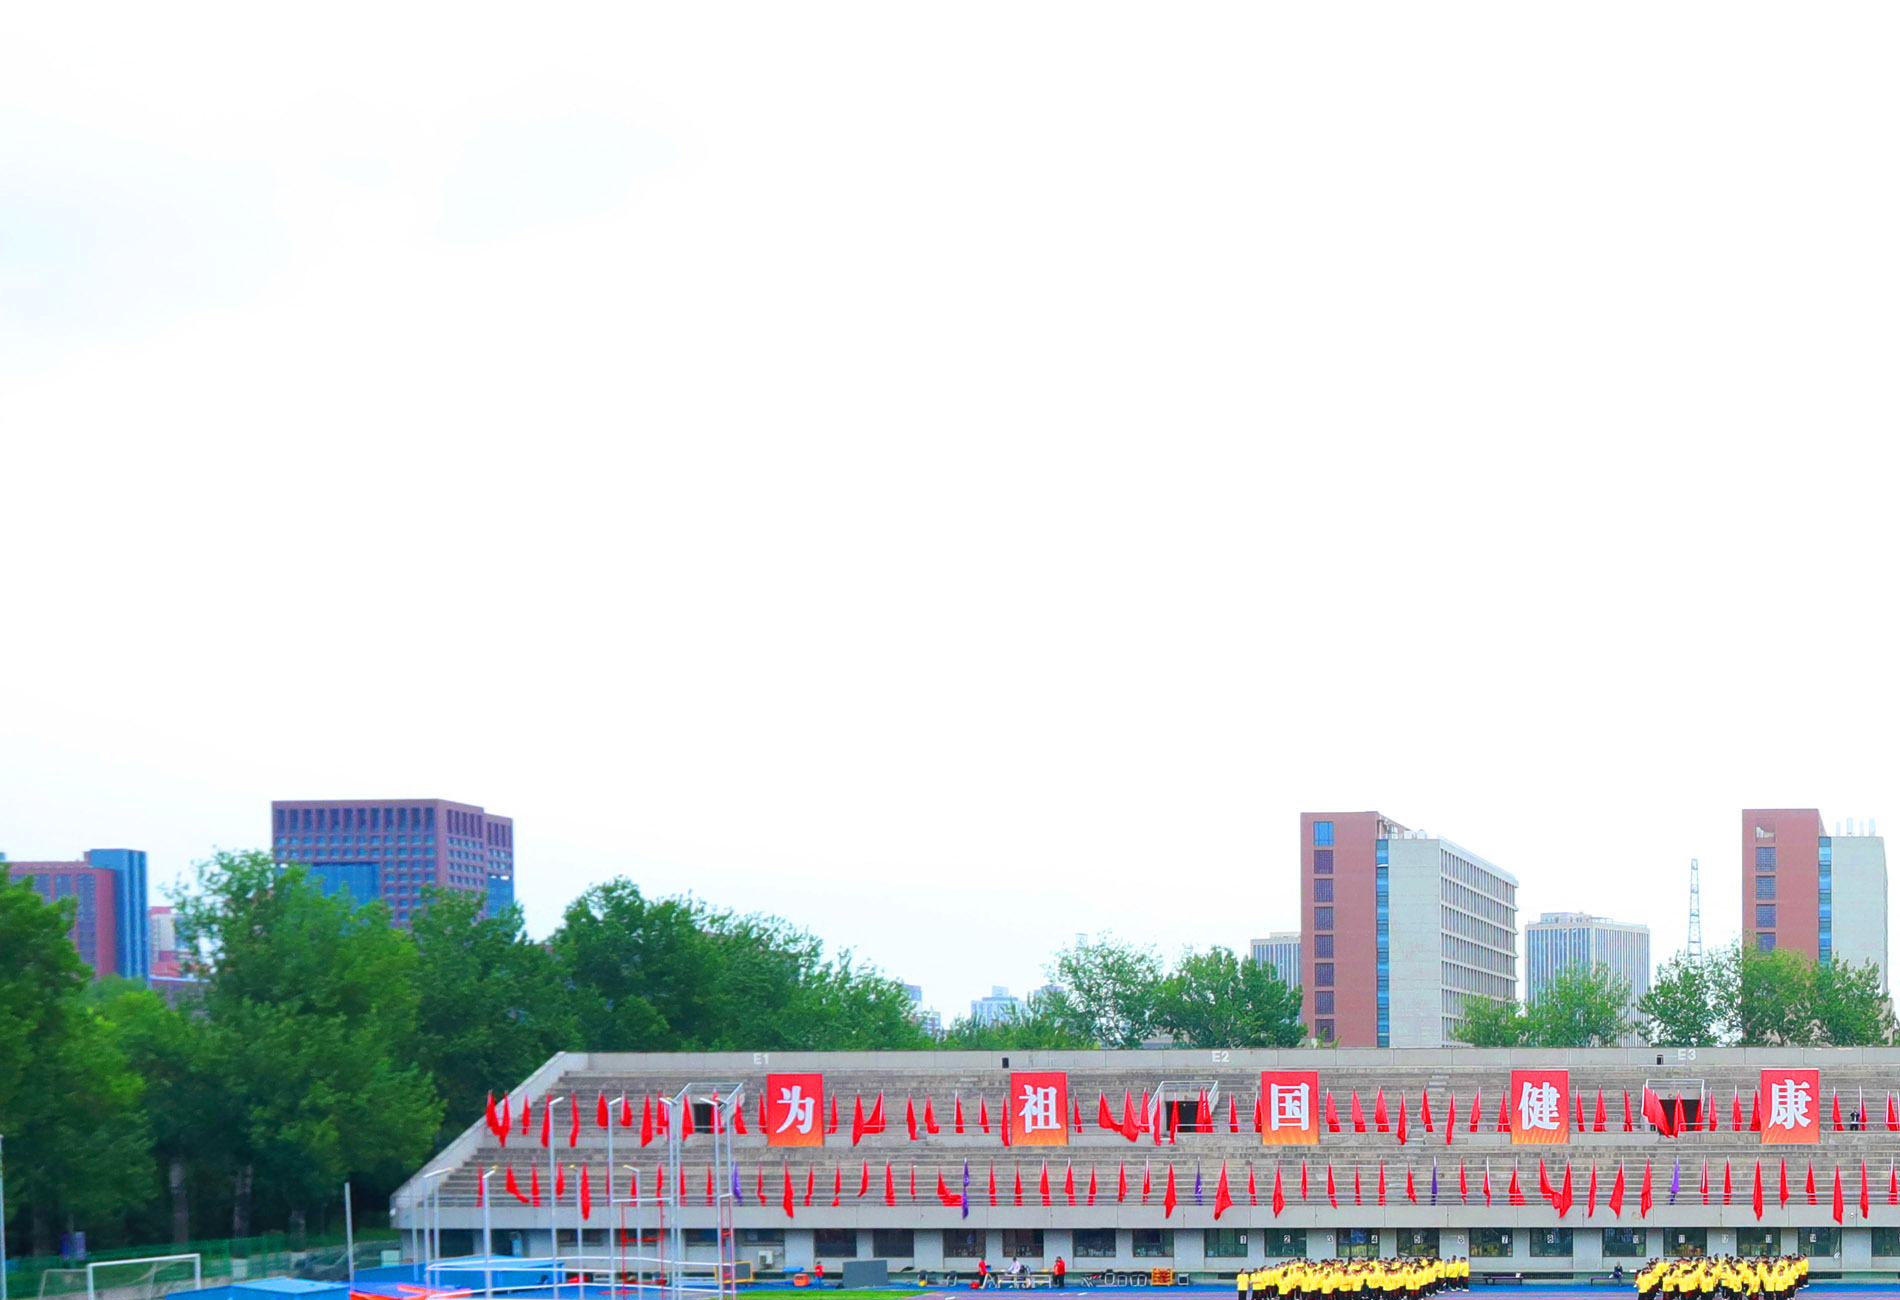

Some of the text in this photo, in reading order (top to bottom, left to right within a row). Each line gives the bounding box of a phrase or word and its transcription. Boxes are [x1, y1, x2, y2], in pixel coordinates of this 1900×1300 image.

[753, 1053, 769, 1064] E1
[1211, 1051, 1229, 1062] E2
[1677, 1049, 1696, 1060] E3
[776, 1086, 814, 1134] 为
[1019, 1085, 1061, 1133] 祖
[1271, 1083, 1309, 1131] 国
[1518, 1082, 1561, 1131] 健
[1768, 1079, 1812, 1130] 康
